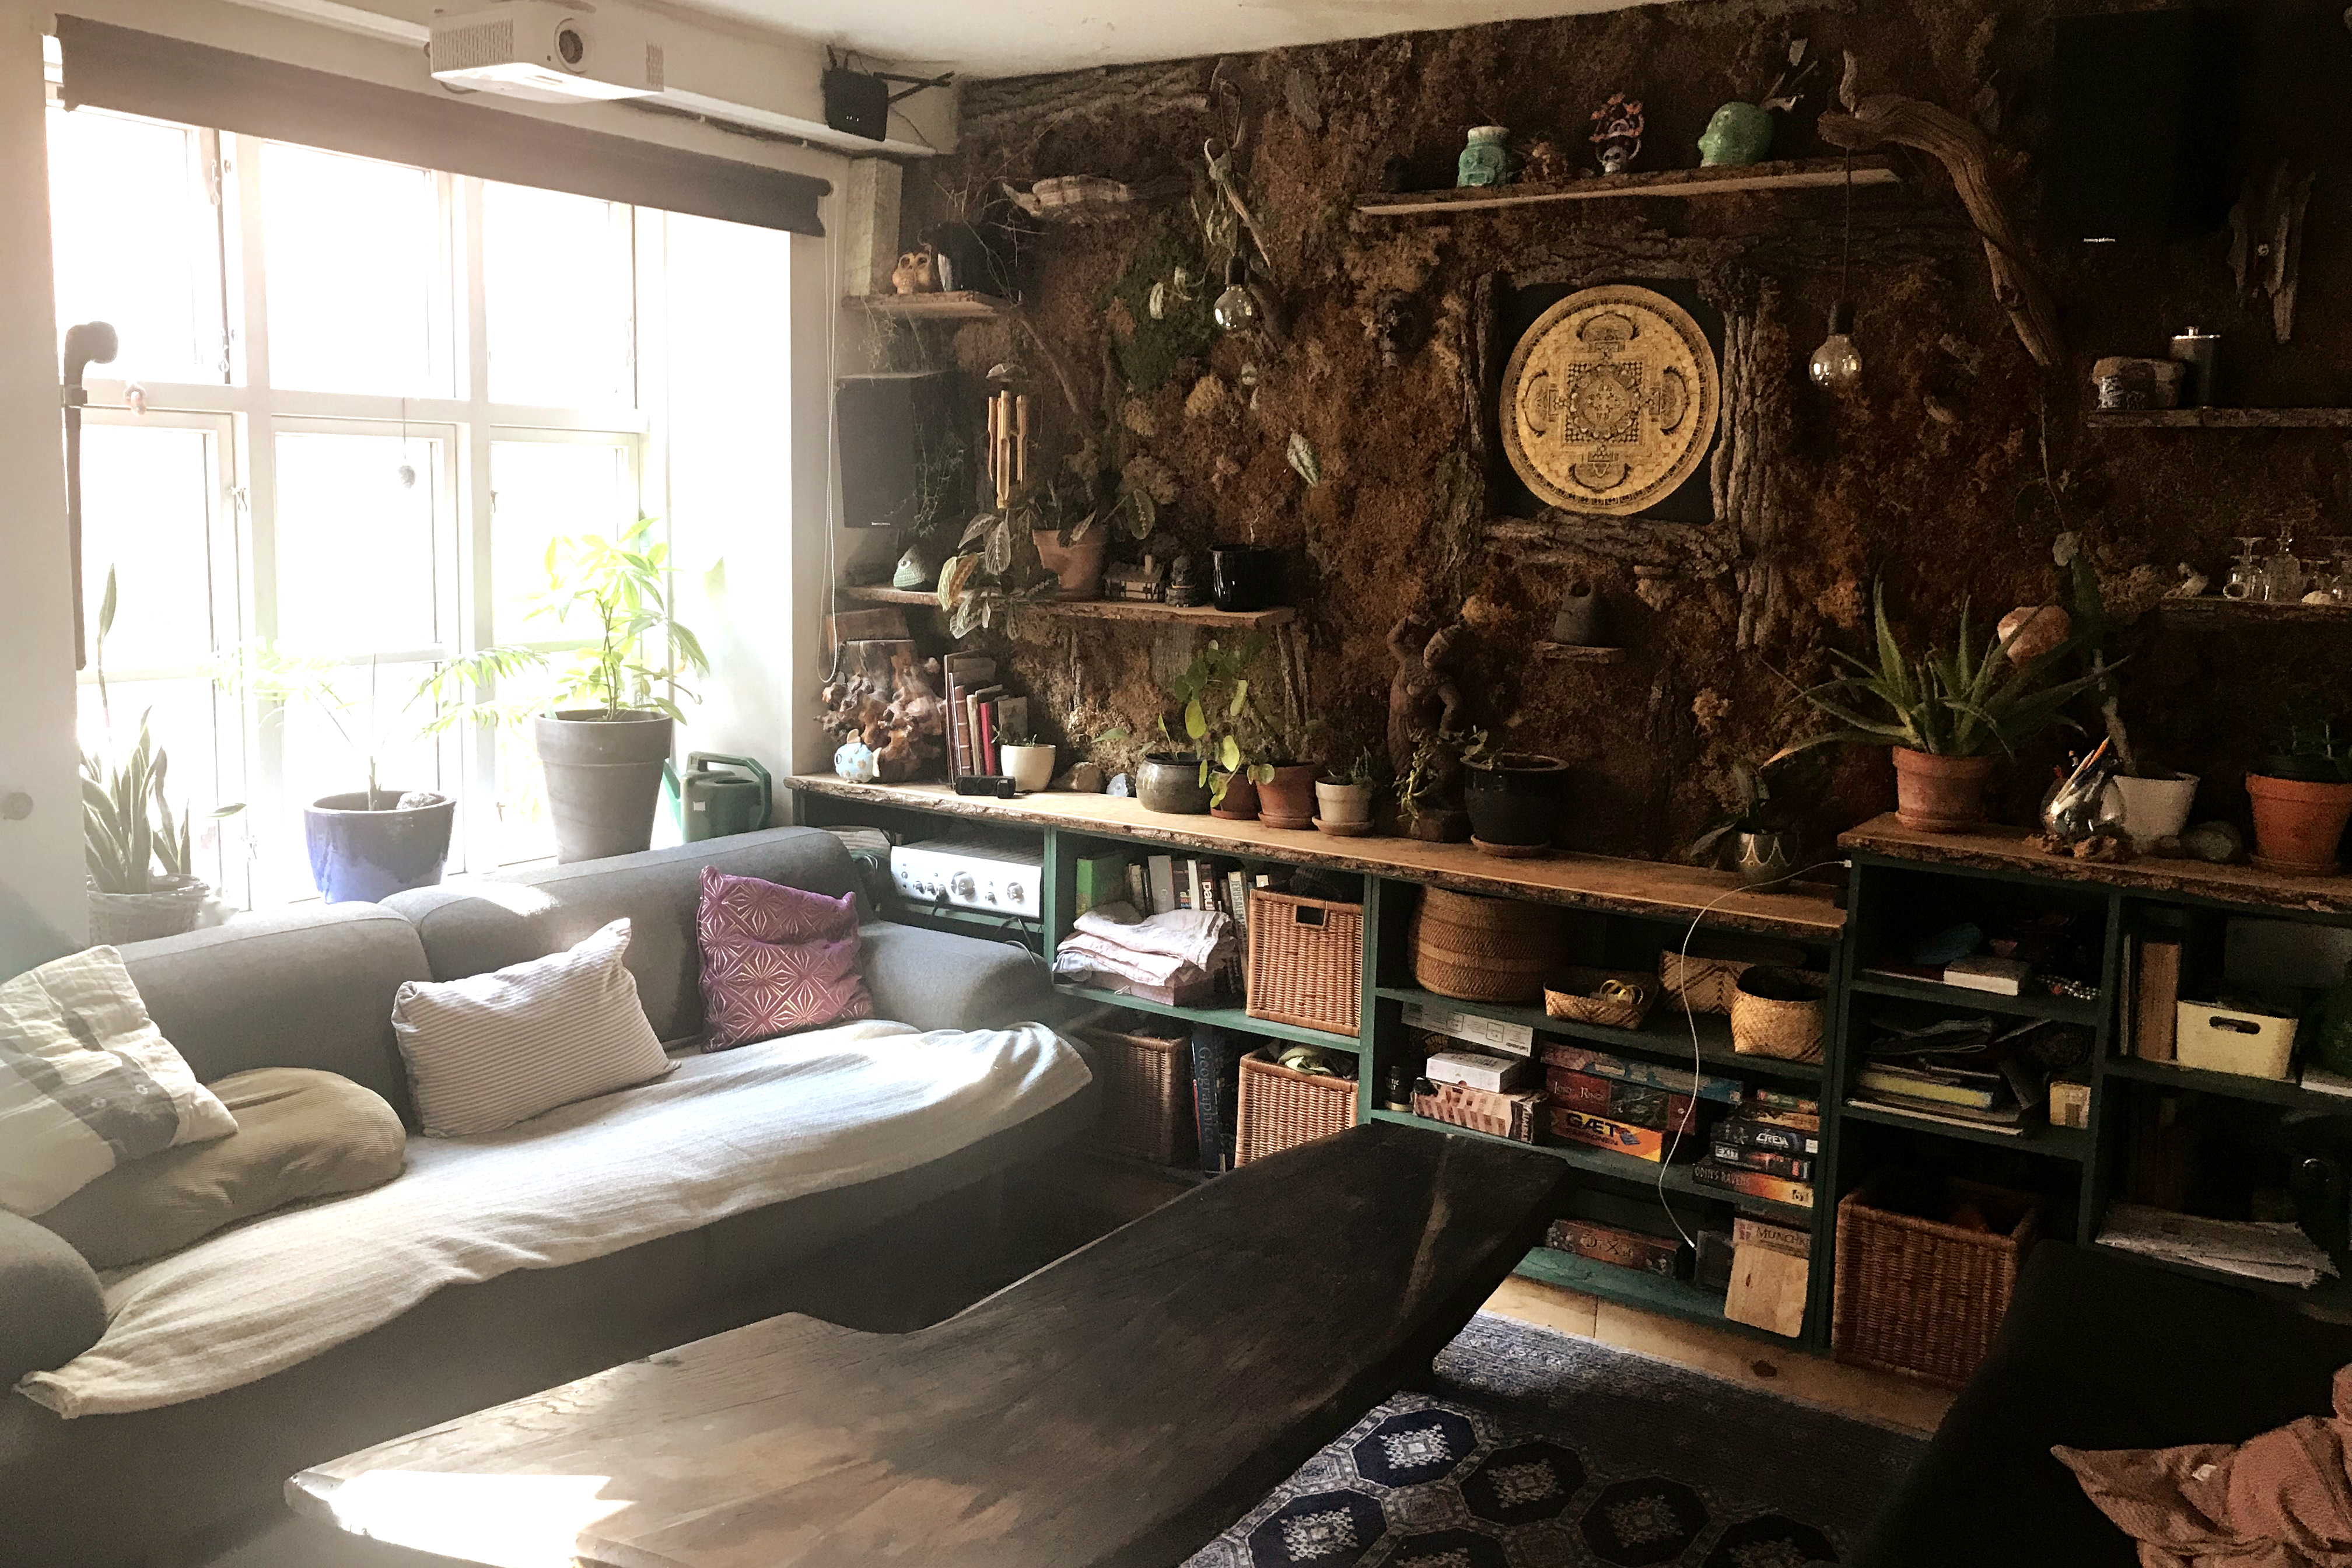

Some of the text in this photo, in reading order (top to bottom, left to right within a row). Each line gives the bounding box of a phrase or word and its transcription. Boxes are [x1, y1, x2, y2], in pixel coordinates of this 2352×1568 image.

[1202, 881, 1215, 910] paul
[1231, 880, 1245, 920] JERUSALEM
[1566, 1112, 1618, 1138] GÆT
[1717, 1145, 1738, 1159] EXIT
[1756, 1133, 1789, 1149] CREW
